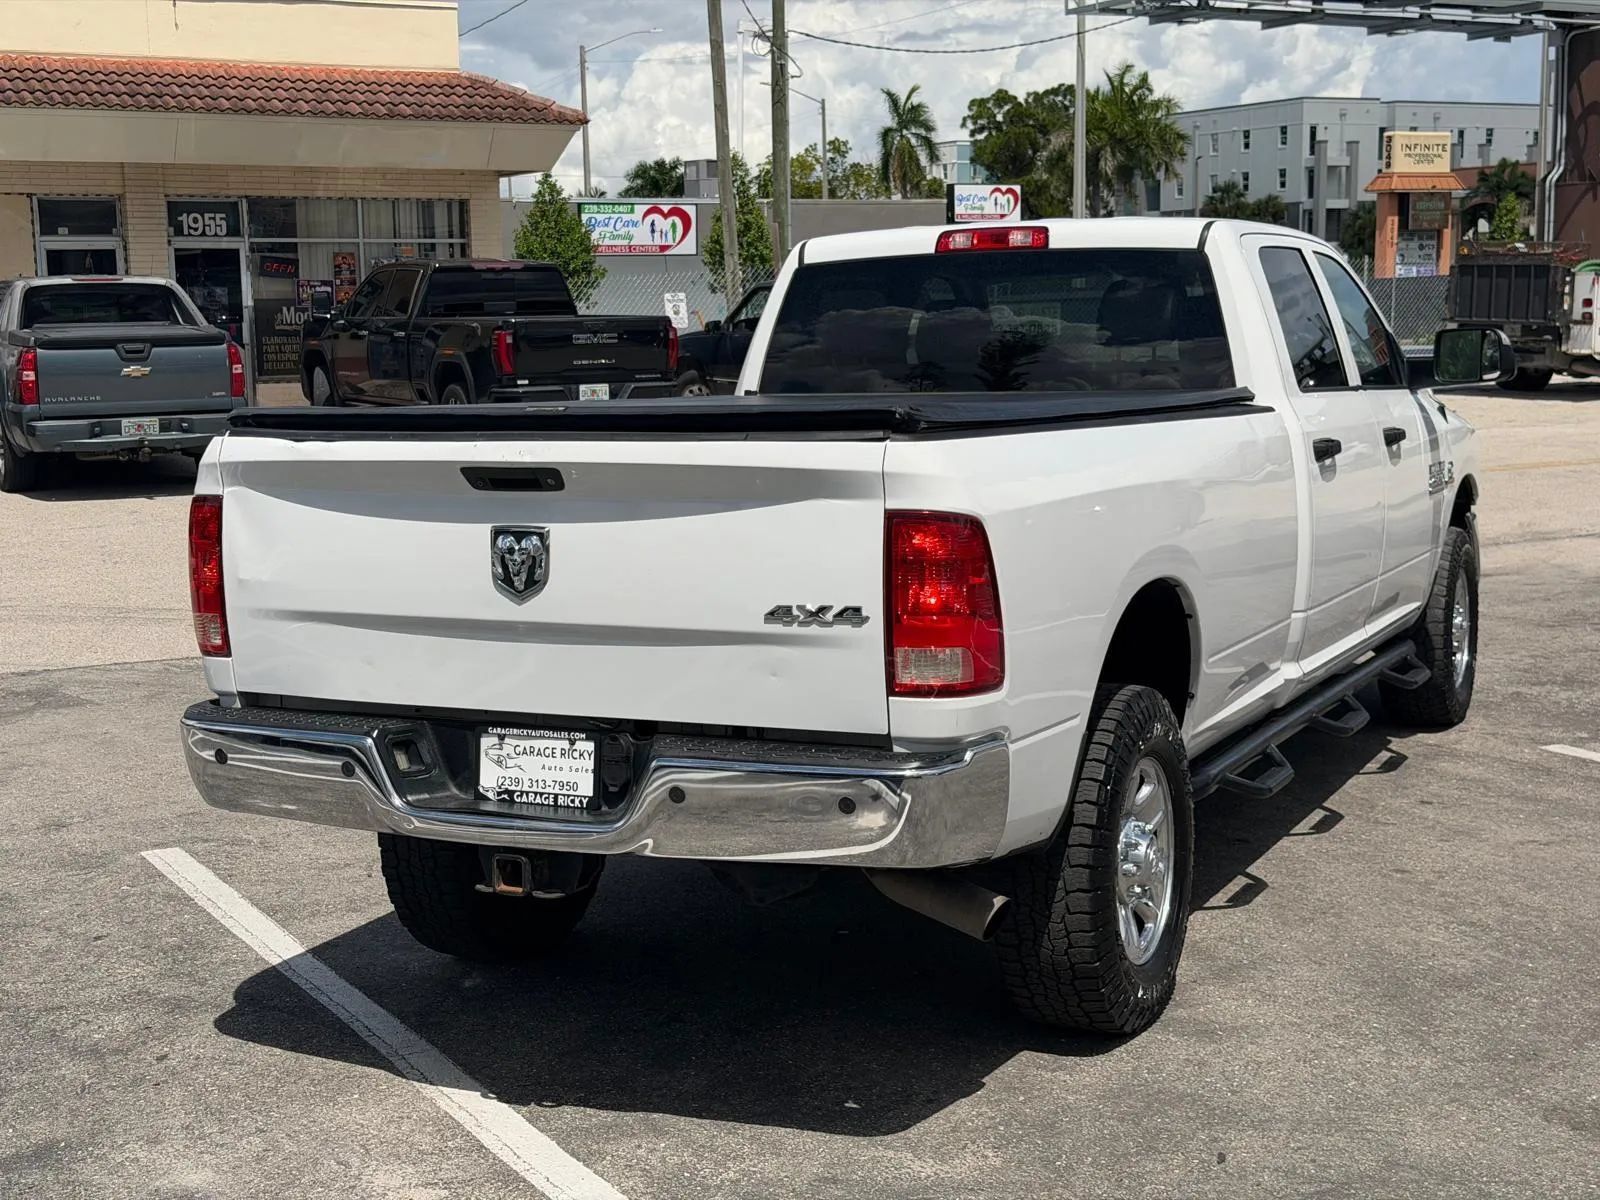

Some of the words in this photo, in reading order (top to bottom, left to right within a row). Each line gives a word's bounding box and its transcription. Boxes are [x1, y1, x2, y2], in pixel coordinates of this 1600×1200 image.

[1400, 143, 1448, 152] INFINITE
[177, 212, 227, 236] 1955
[586, 216, 614, 233] Best
[613, 216, 640, 231] Care
[597, 230, 634, 244] Family
[572, 333, 619, 344] GMC
[44, 395, 102, 403] AVALANCHE
[763, 604, 871, 628] 4X4
[487, 727, 586, 740] GARAGERICKYAUTOSALES.COM
[513, 744, 558, 758] GARAGE
[560, 748, 594, 761] RICKY
[541, 763, 564, 772] Auto
[568, 766, 594, 774] Sales
[496, 775, 524, 789] (239)
[527, 778, 579, 792] 313-7950
[513, 792, 555, 806] GARAGE
[557, 795, 589, 808] RICKY
